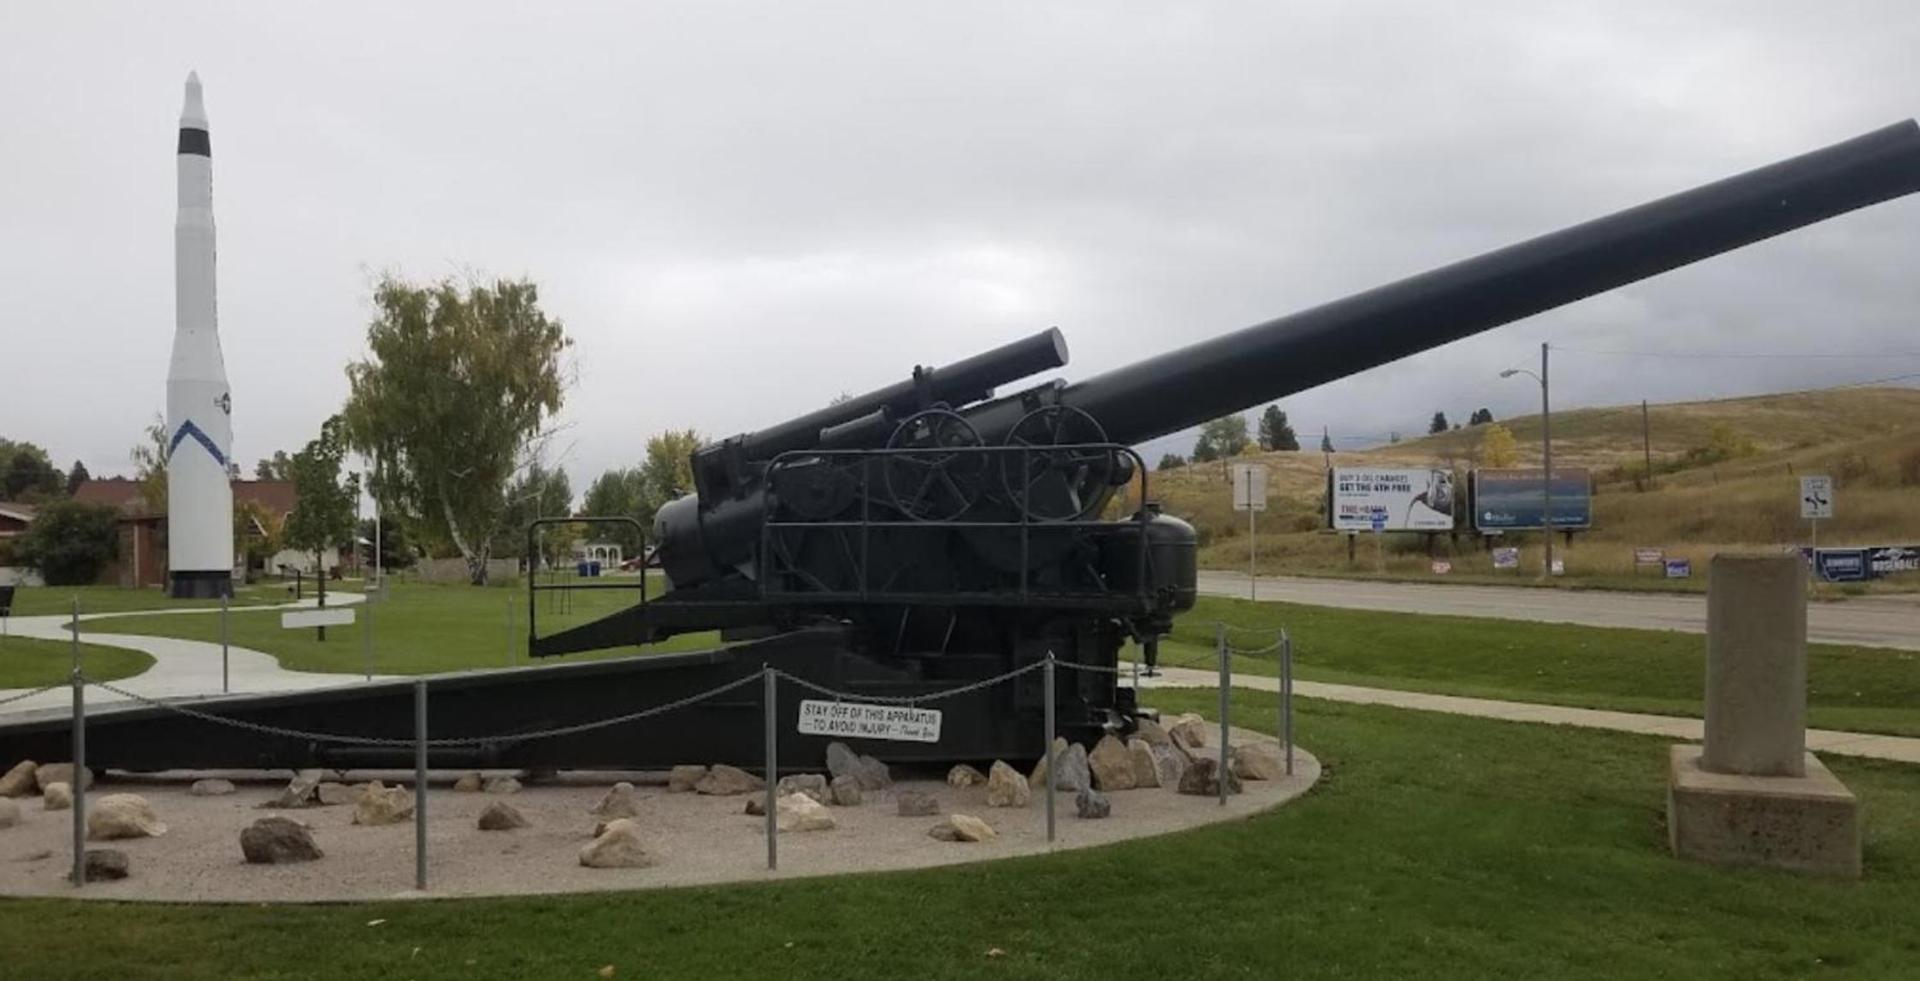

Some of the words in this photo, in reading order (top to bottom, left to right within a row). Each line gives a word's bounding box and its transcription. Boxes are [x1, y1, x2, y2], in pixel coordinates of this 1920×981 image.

[1339, 483, 1354, 492] GET
[1357, 483, 1371, 492] THE
[1373, 483, 1390, 492] 4TH
[1392, 484, 1411, 492] FREE
[804, 703, 828, 717] STAY
[830, 705, 849, 719] OFF
[850, 707, 862, 719] OF
[865, 708, 884, 721] THIS
[886, 710, 937, 725] APPARATUS
[828, 720, 857, 733] AVOID
